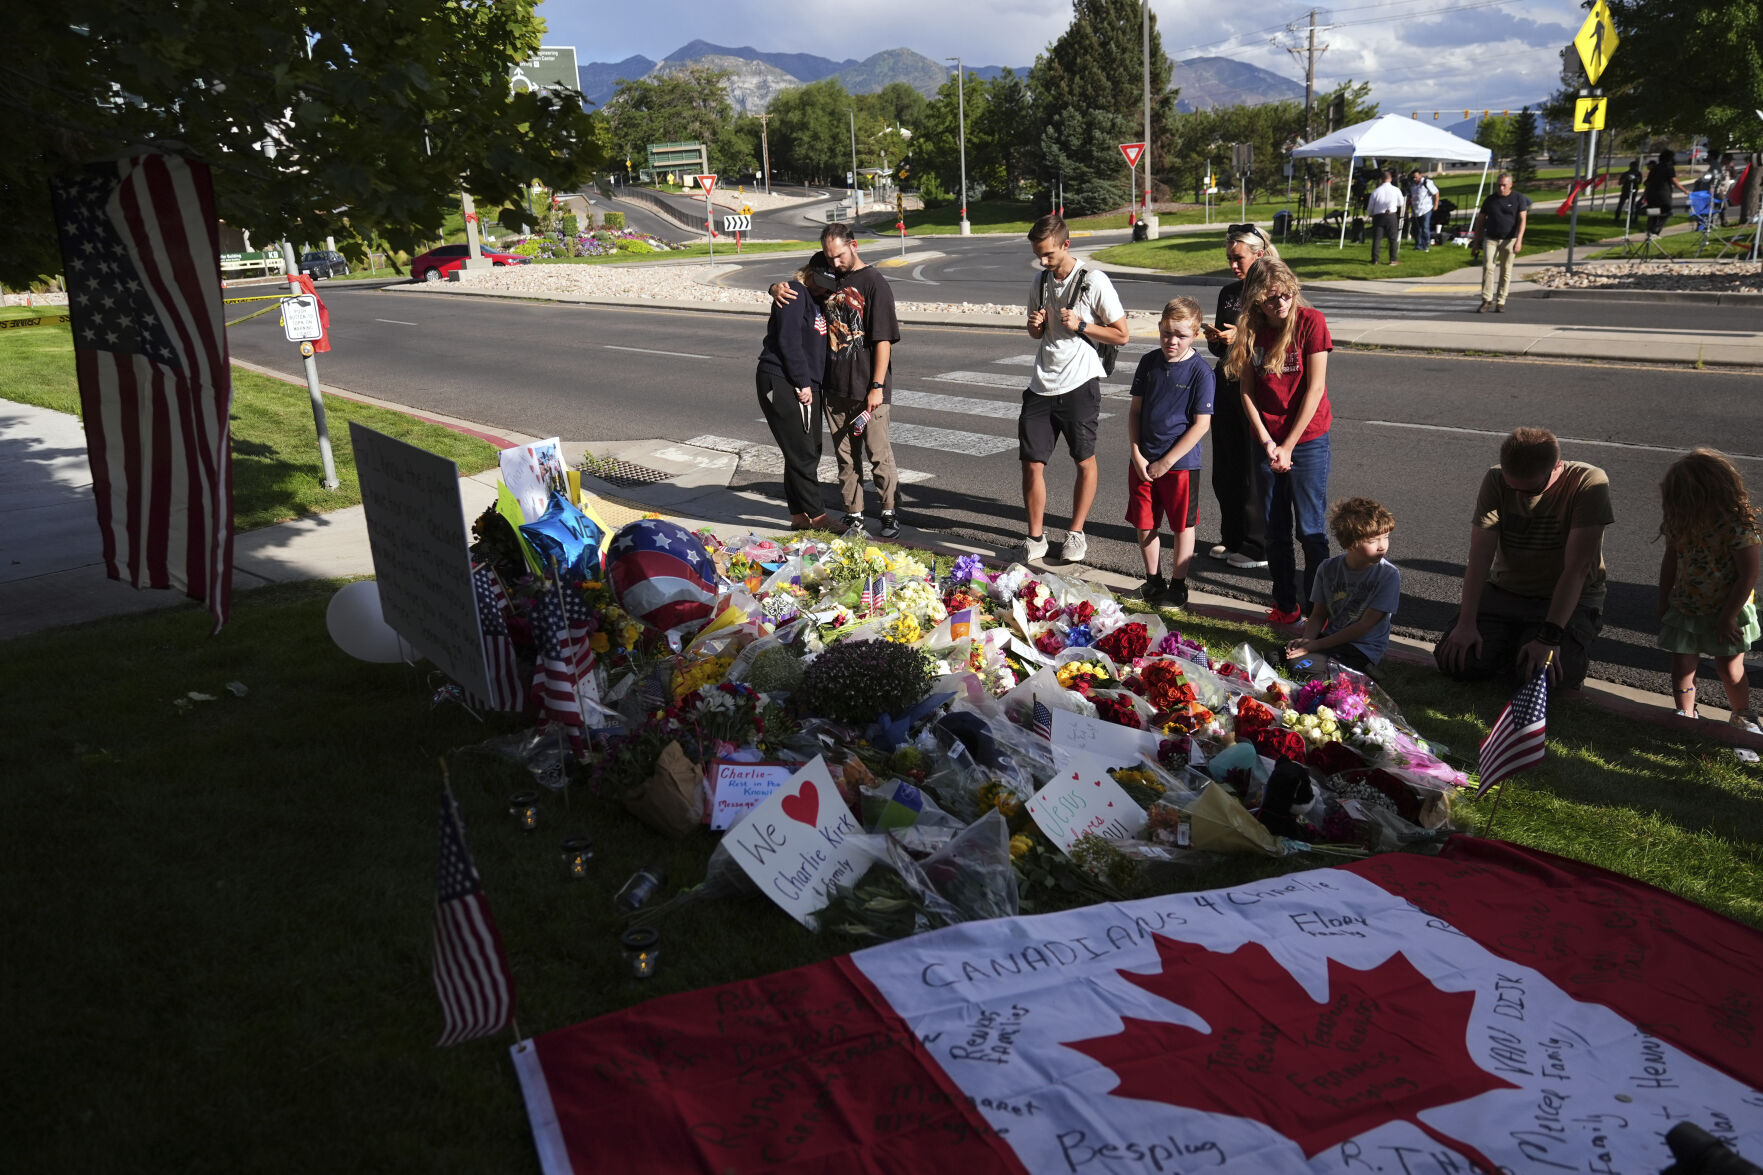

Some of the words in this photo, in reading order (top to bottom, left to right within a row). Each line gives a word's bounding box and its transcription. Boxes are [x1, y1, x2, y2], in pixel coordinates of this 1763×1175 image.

[268, 251, 279, 259] KB
[558, 515, 594, 541] WE
[737, 823, 787, 866] We
[773, 848, 827, 901] Charlie
[818, 814, 856, 849] Kirk
[1194, 895, 1224, 916] 4
[1486, 1025, 1534, 1077] VAN
